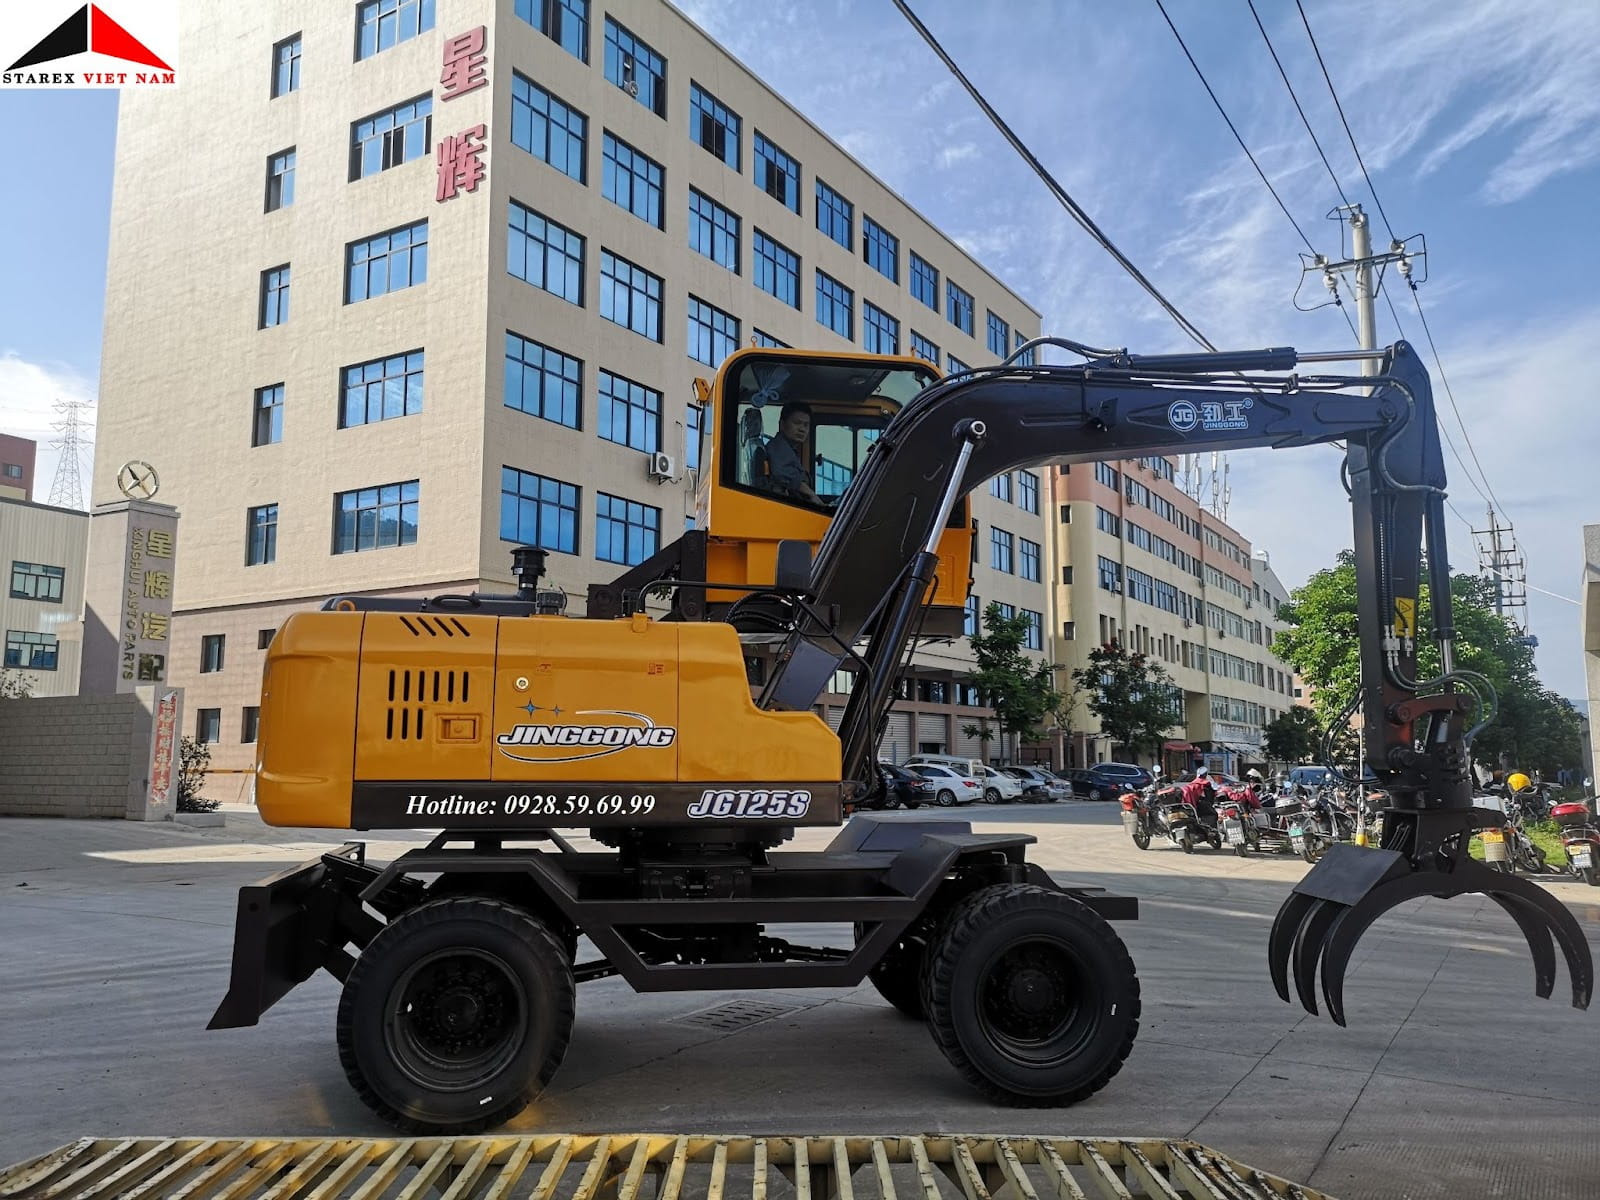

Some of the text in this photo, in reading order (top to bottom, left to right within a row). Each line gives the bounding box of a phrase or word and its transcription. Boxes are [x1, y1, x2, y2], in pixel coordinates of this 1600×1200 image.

[435, 25, 487, 202] 星辉
[1203, 404, 1245, 422] 劲工
[1205, 420, 1247, 429] JINGGONG
[122, 527, 144, 681] XINGHUI AUTO PARTS
[498, 726, 676, 748] JINGGONG
[687, 789, 812, 819] JG125S
